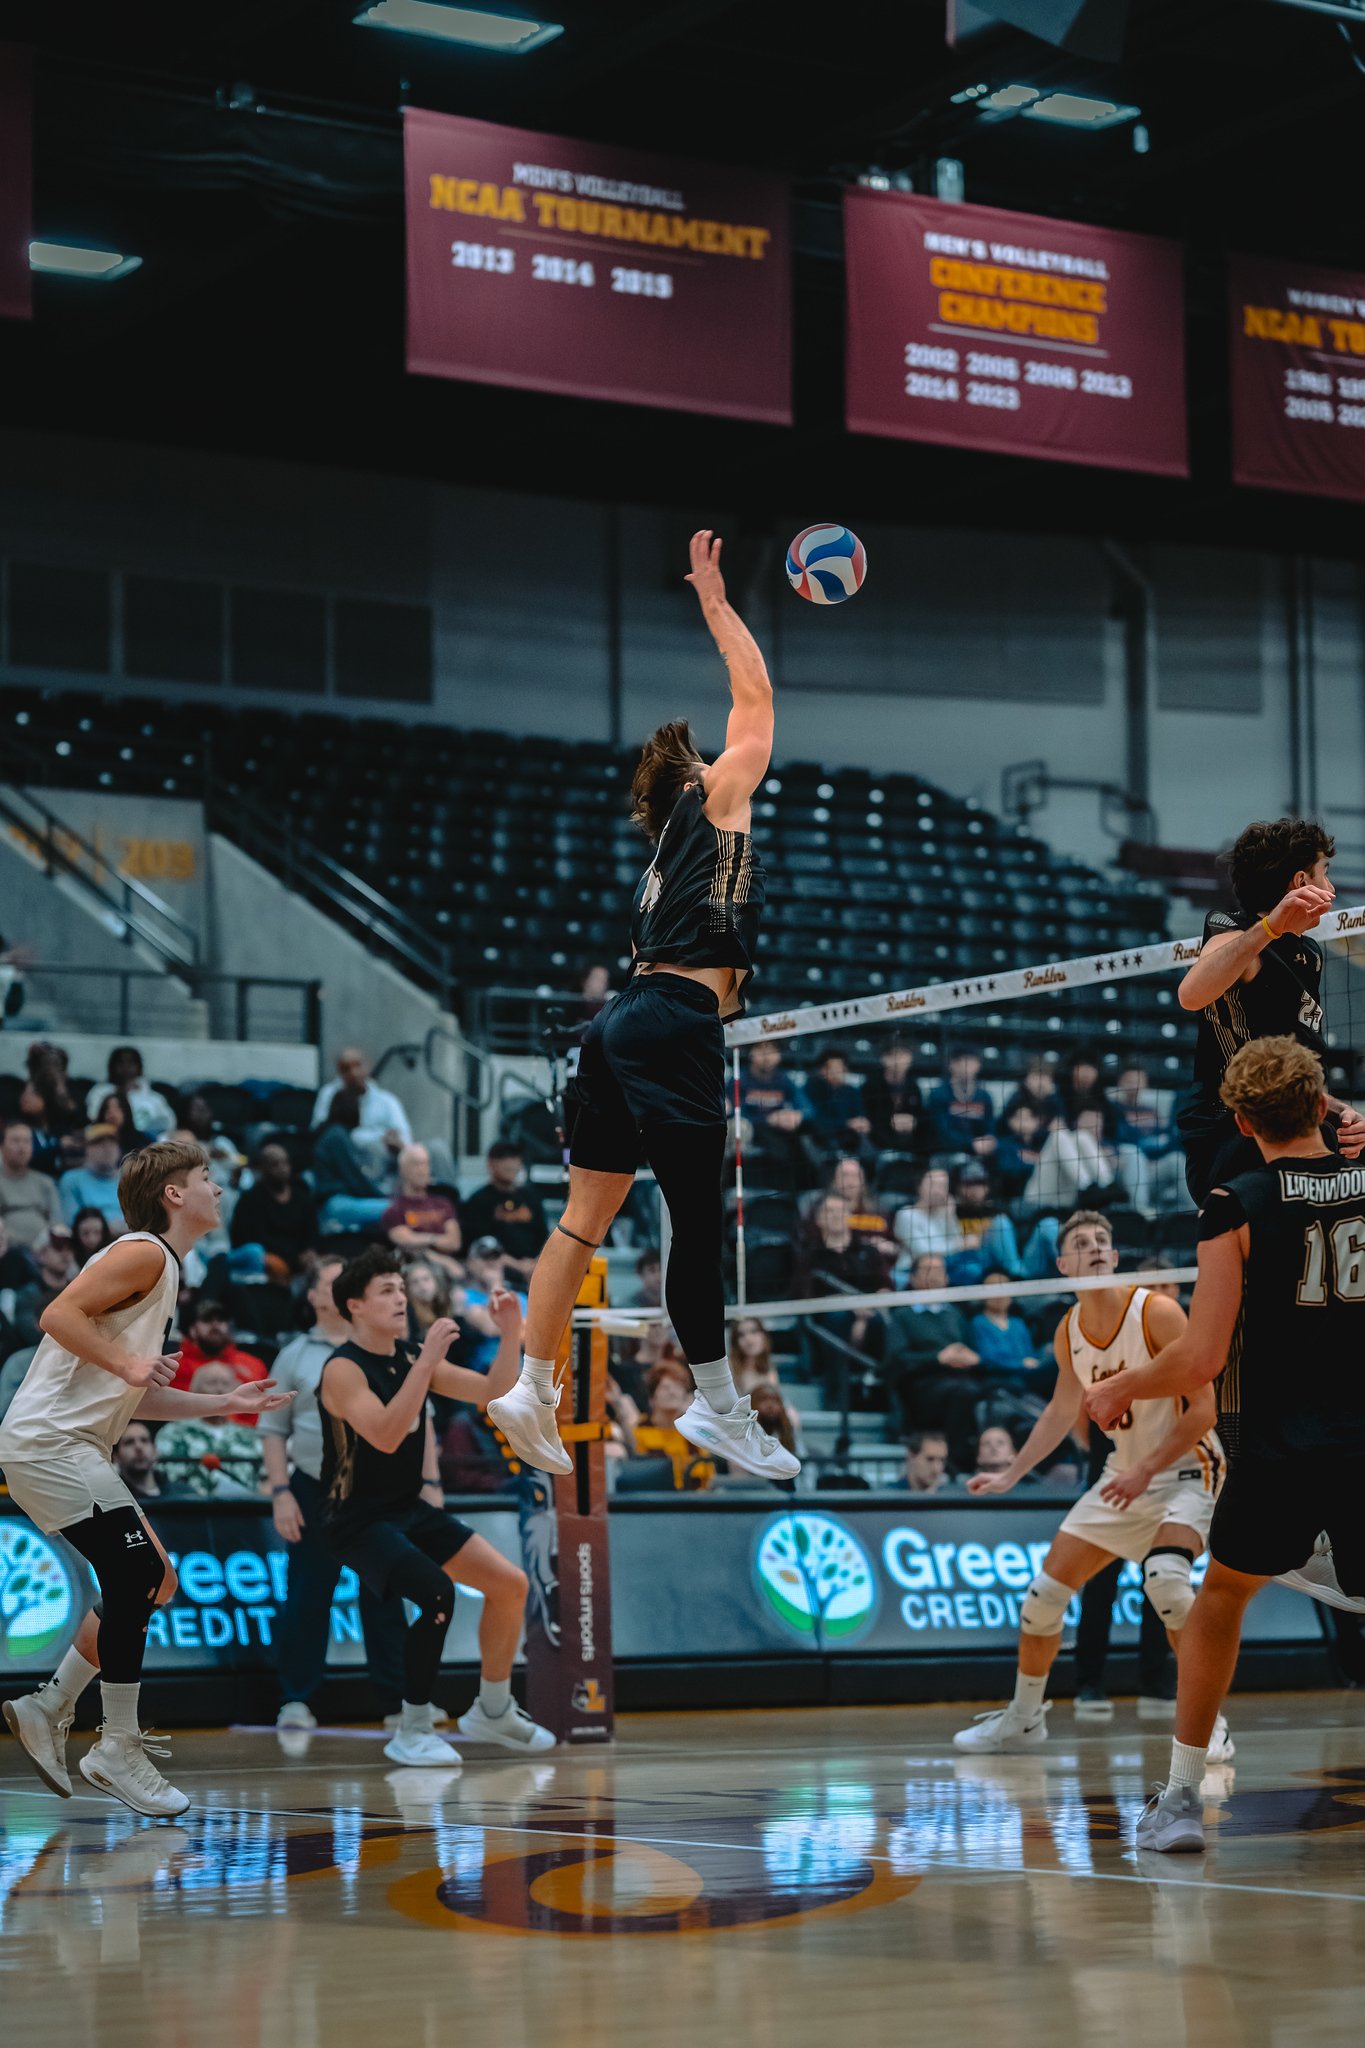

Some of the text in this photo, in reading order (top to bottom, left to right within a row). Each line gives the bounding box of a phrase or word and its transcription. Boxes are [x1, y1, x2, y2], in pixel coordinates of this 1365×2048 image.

[513, 161, 686, 211] MEN'S VOLLEYBALL
[429, 172, 770, 260] NCAA TOURNAMENT
[450, 240, 673, 299] 2013 2014 2015
[923, 231, 1110, 281] MEN'S VOLLEYBALL
[929, 256, 1108, 314] CONFERENCE
[938, 291, 1099, 345] CHAMPIONS
[1243, 304, 1324, 348] NCAA
[904, 342, 960, 372] 2002
[1023, 965, 1067, 989] Ramblers
[1296, 1216, 1365, 1306] 16
[147, 1605, 276, 1647] REDIT
[577, 1542, 595, 1662] sports imports
